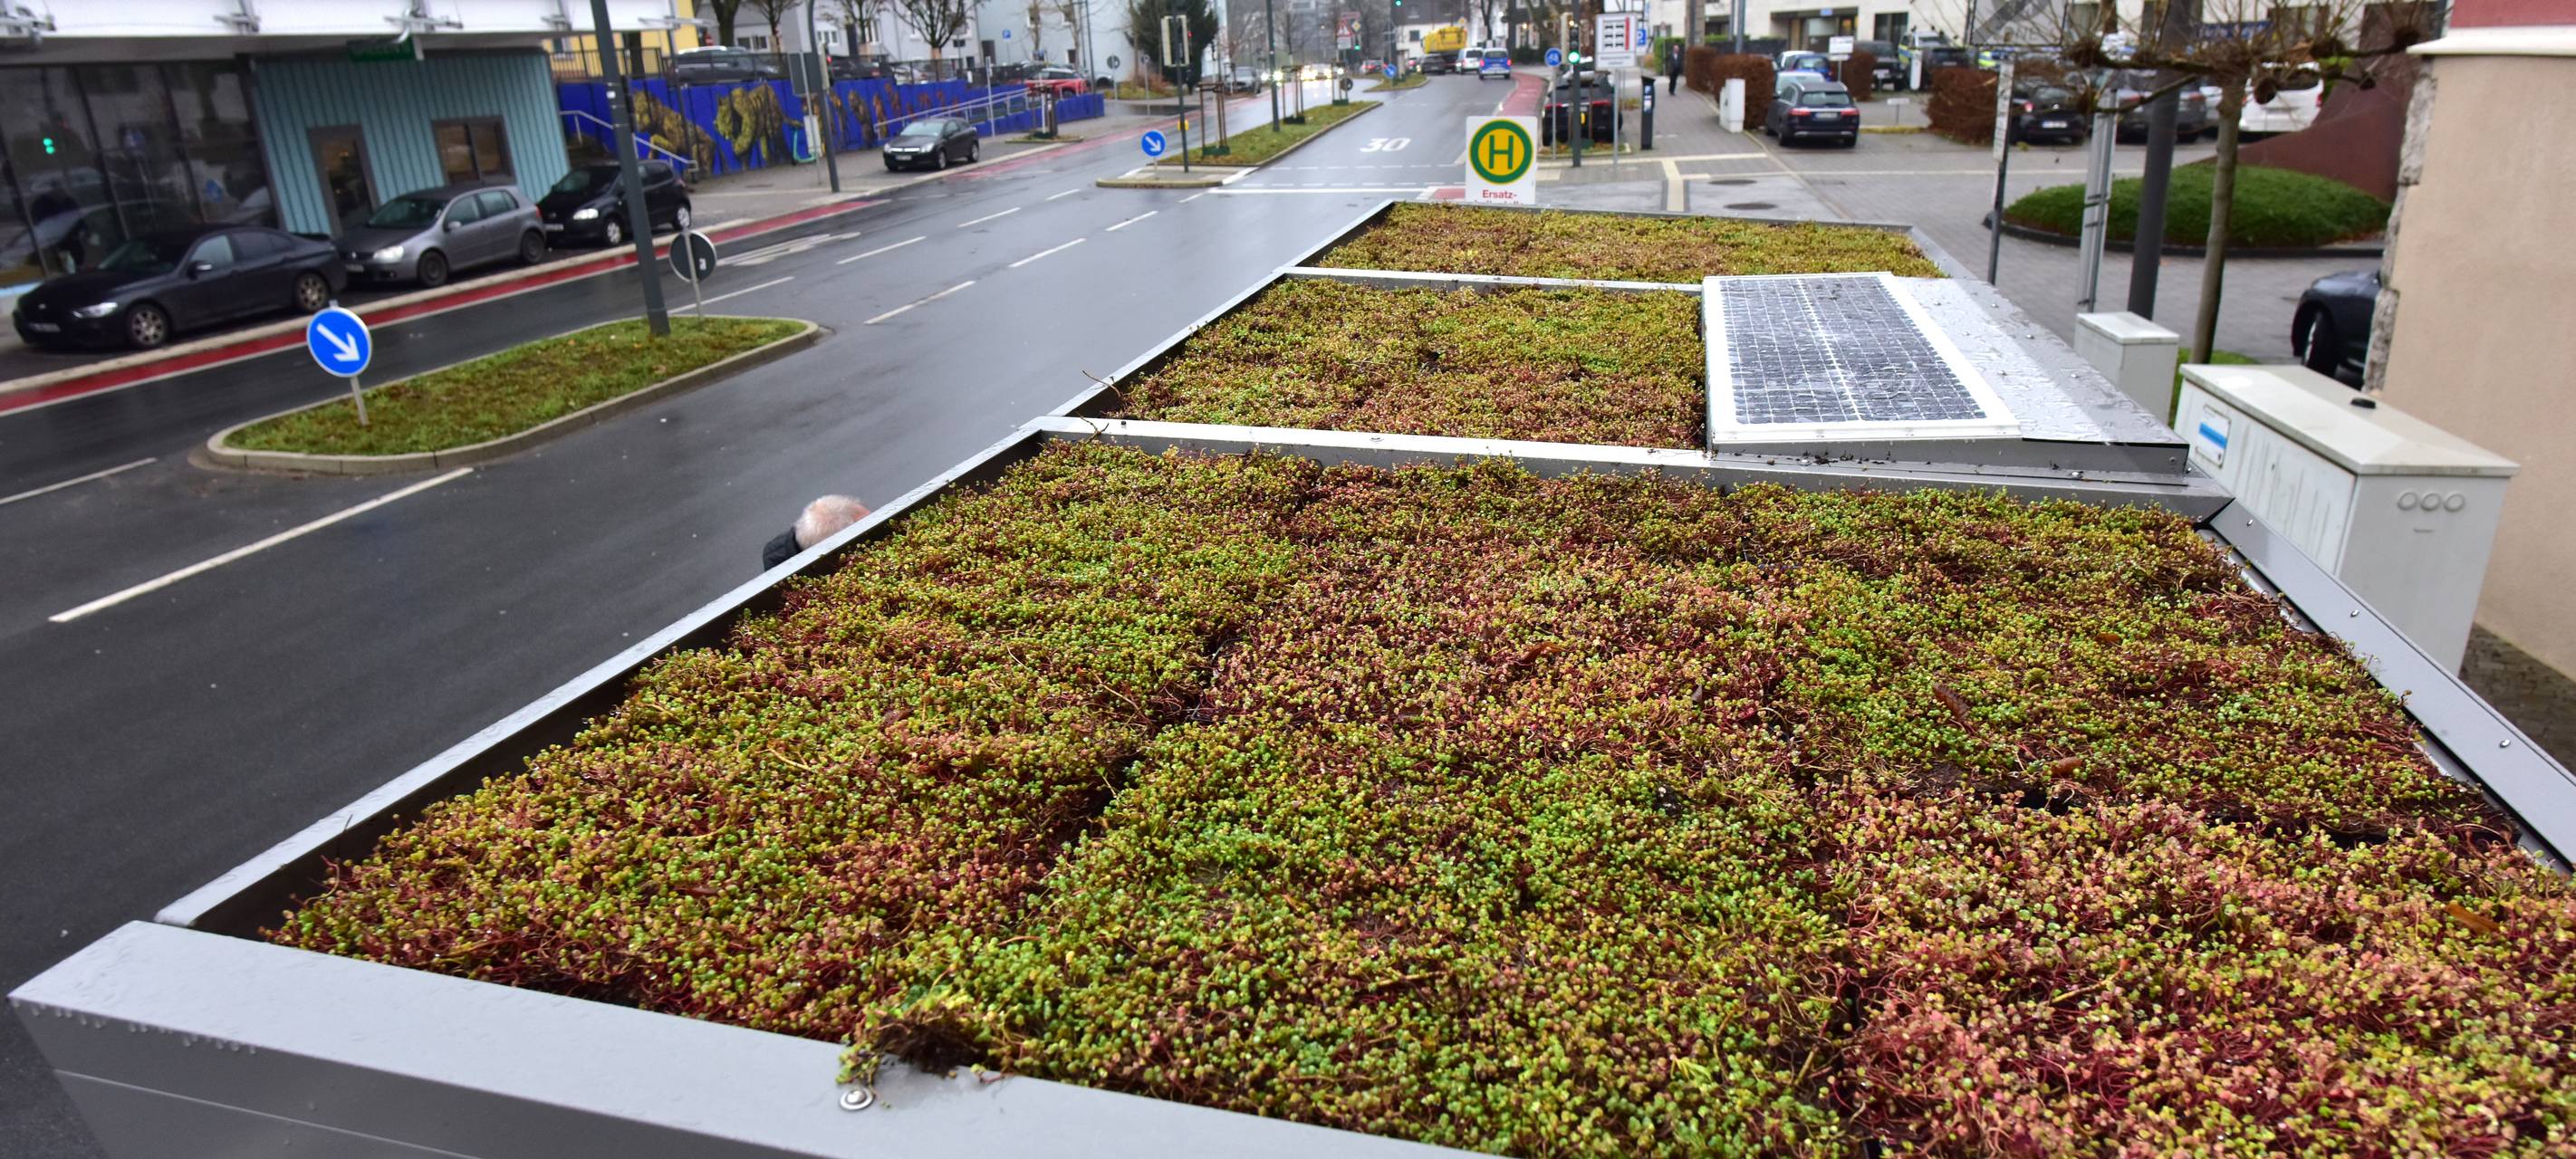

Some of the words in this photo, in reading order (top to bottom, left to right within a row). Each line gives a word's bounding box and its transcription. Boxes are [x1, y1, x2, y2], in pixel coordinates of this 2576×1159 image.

[1360, 138, 1410, 152] 30
[1488, 135, 1514, 169] H
[1482, 189, 1517, 198] Ersatz-
